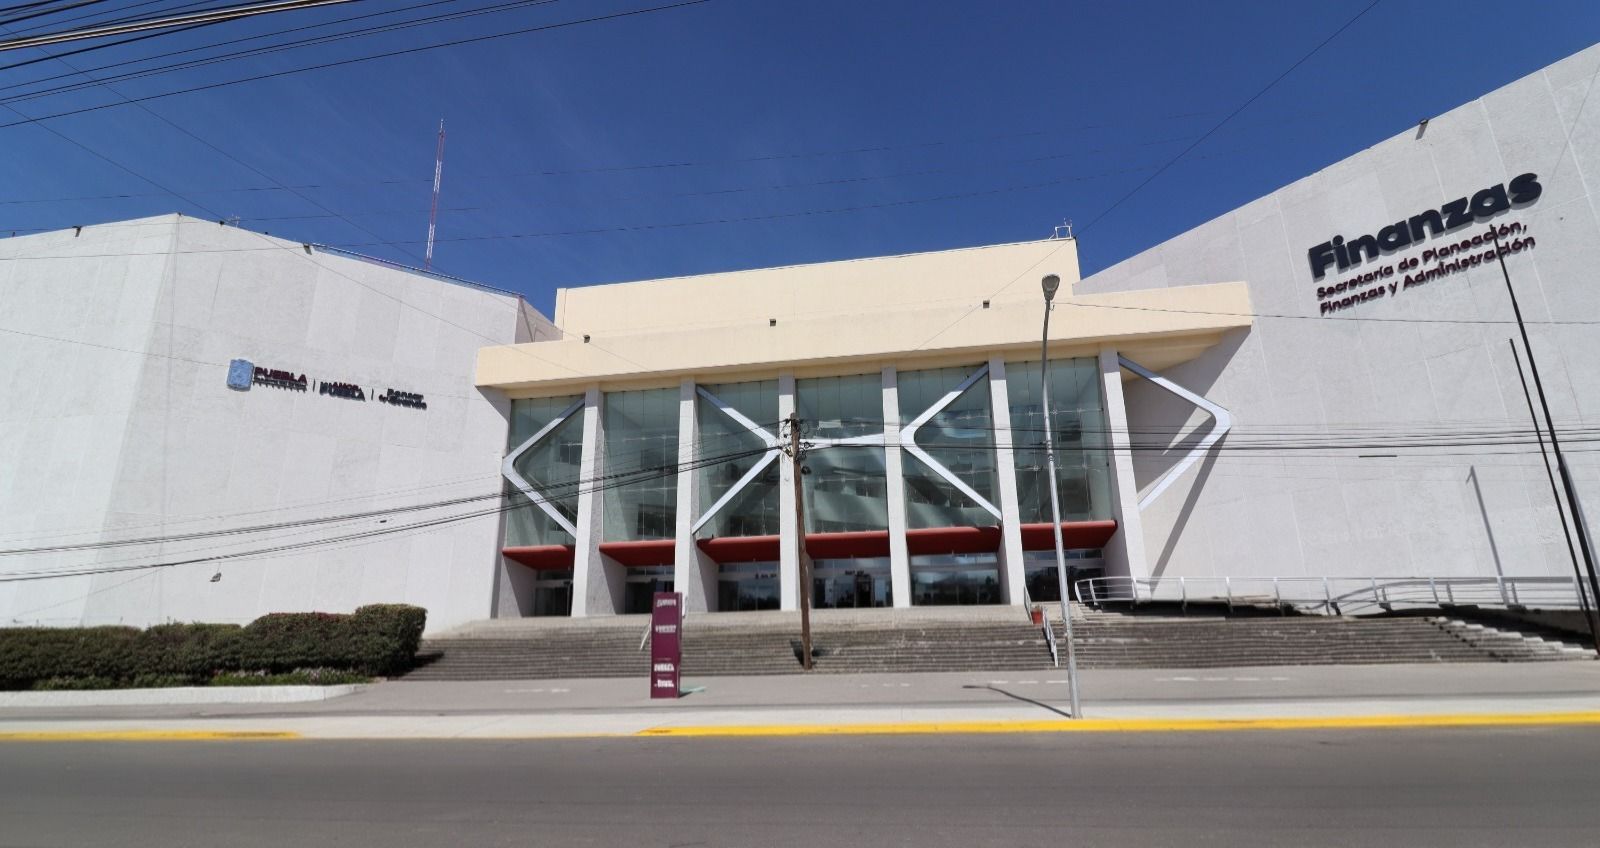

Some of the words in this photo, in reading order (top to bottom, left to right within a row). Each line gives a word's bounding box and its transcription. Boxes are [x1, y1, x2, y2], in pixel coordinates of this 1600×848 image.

[1308, 172, 1542, 281] Finanzas
[1317, 265, 1394, 299] Secretaría
[1398, 257, 1419, 272] de
[1320, 285, 1386, 315] Finanzas
[1388, 281, 1398, 297] y
[254, 366, 307, 386] PUEBLA
